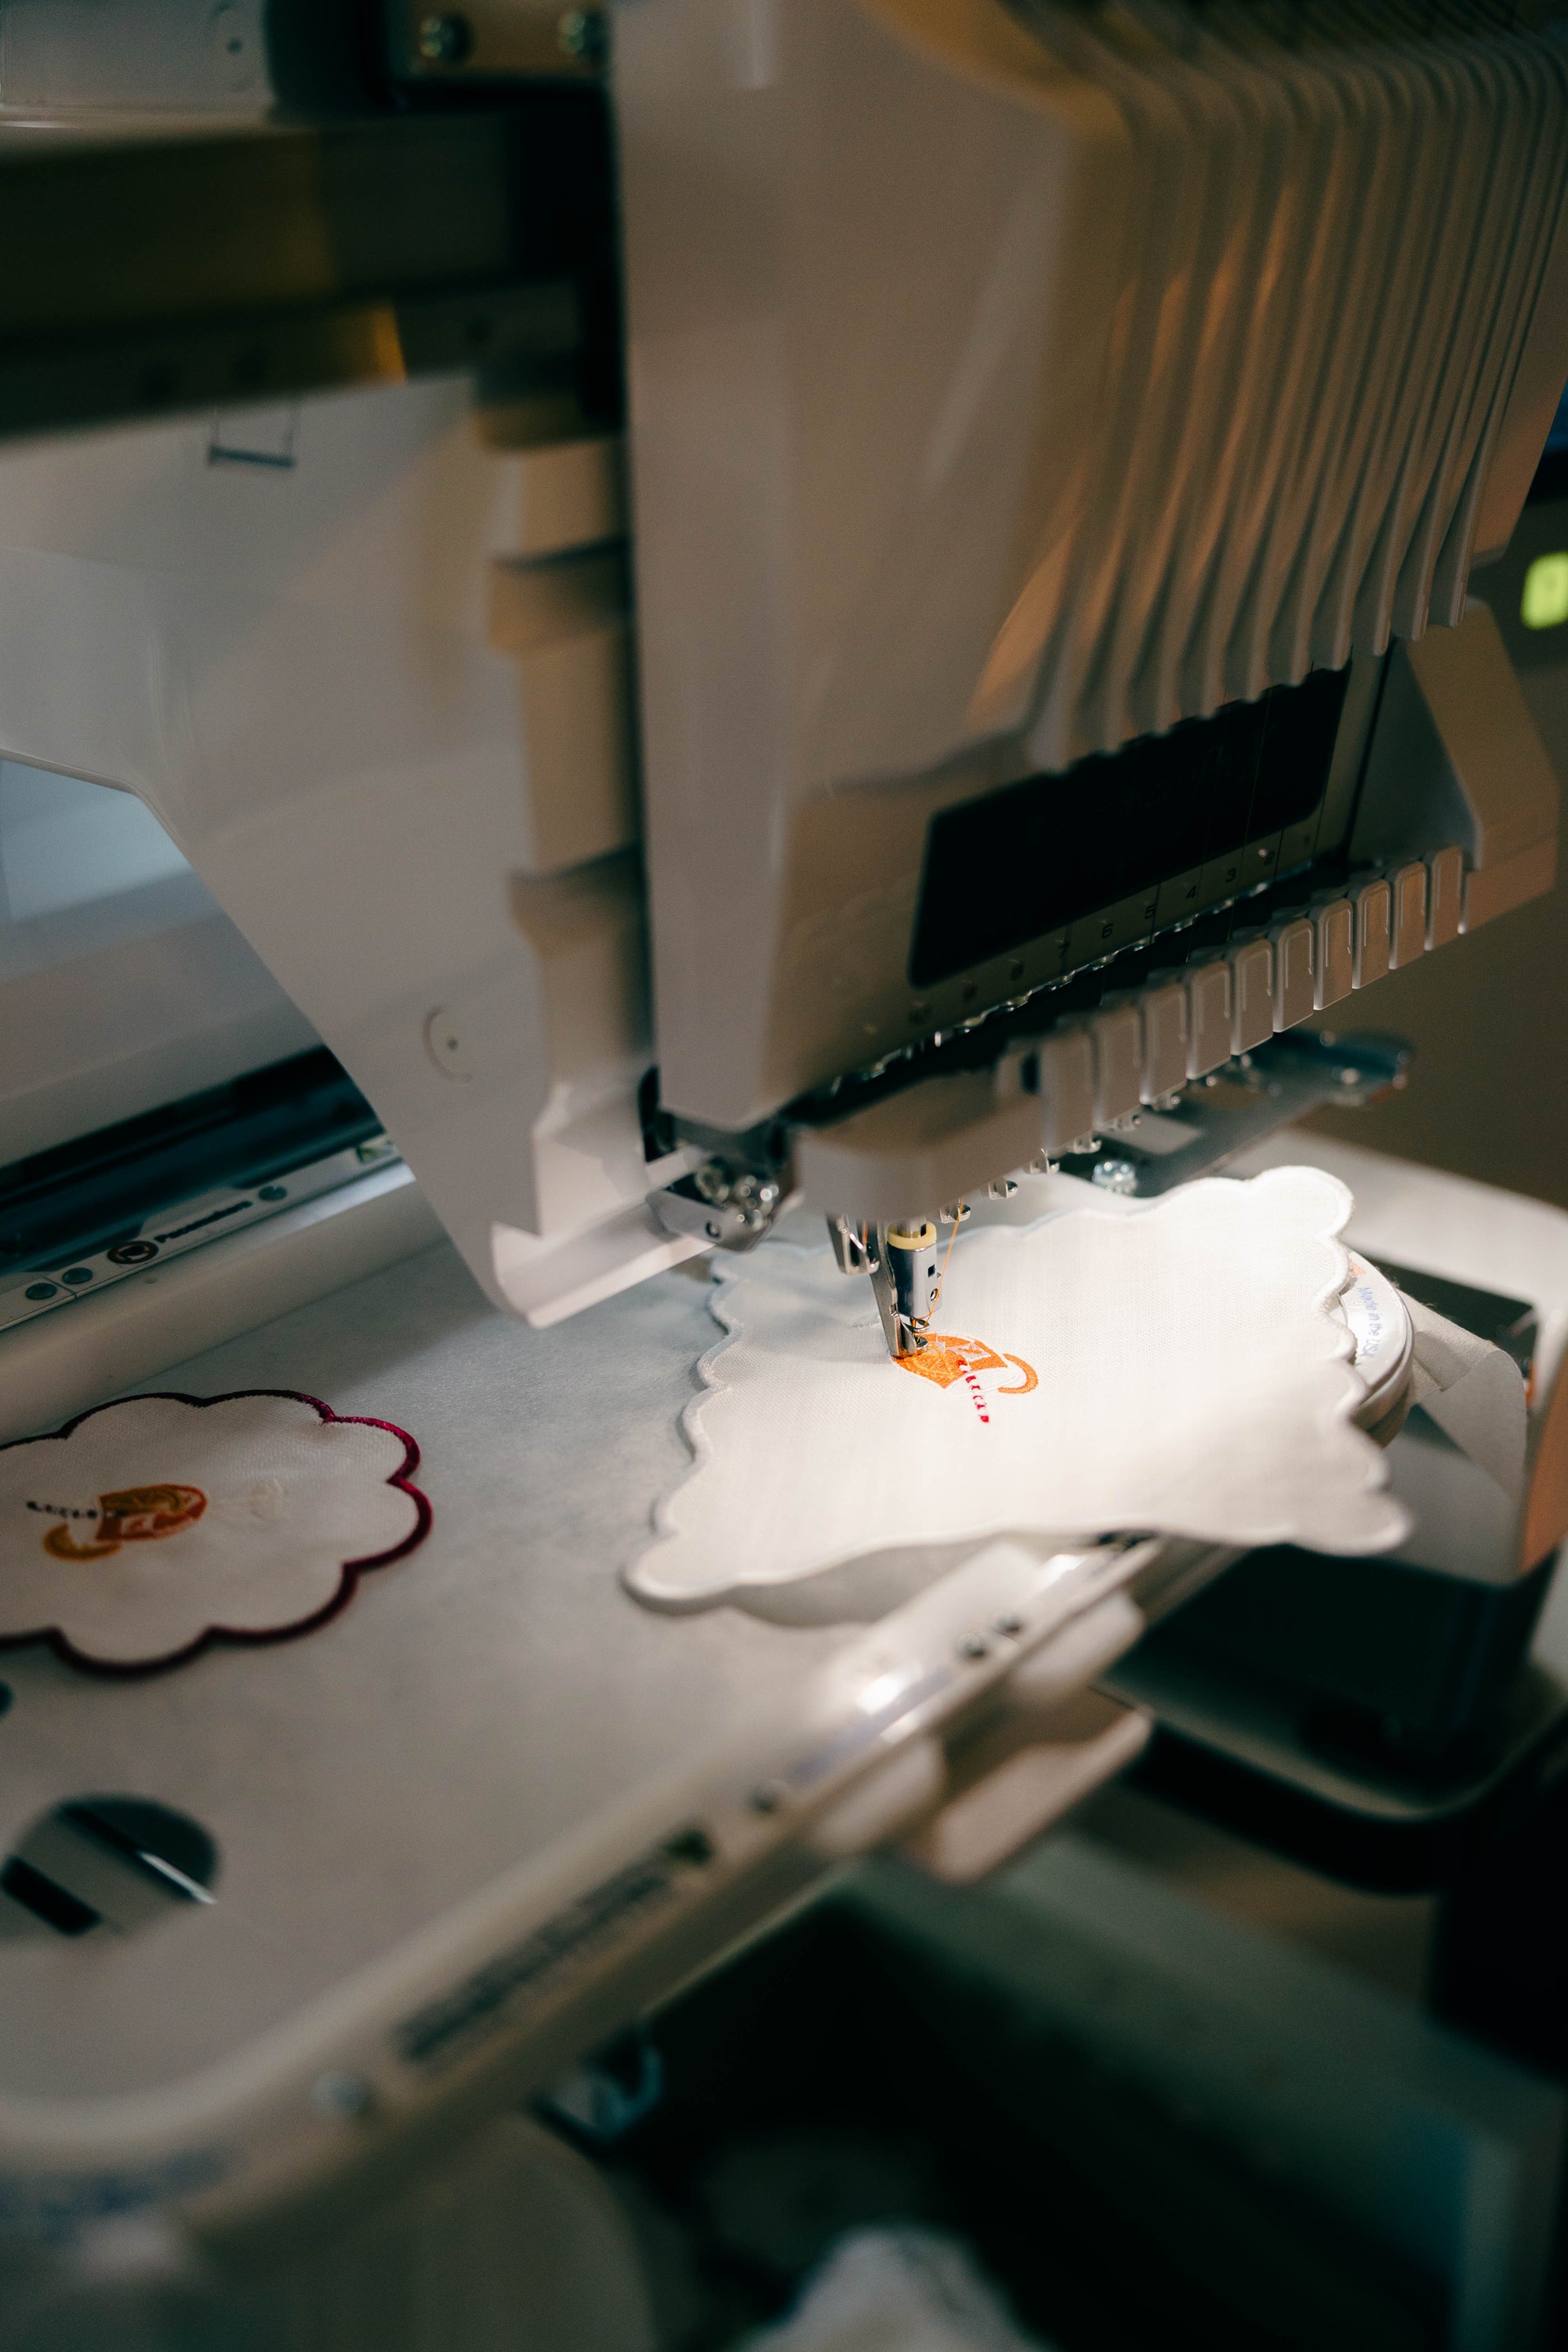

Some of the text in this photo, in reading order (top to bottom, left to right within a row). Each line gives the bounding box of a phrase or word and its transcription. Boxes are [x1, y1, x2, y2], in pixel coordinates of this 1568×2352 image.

[1101, 923, 1113, 939] 6
[1145, 903, 1156, 920] 5
[1185, 885, 1196, 899] 4
[1225, 867, 1236, 883] 3
[1368, 1323, 1383, 1336] the
[1359, 1338, 1381, 1358] USA
